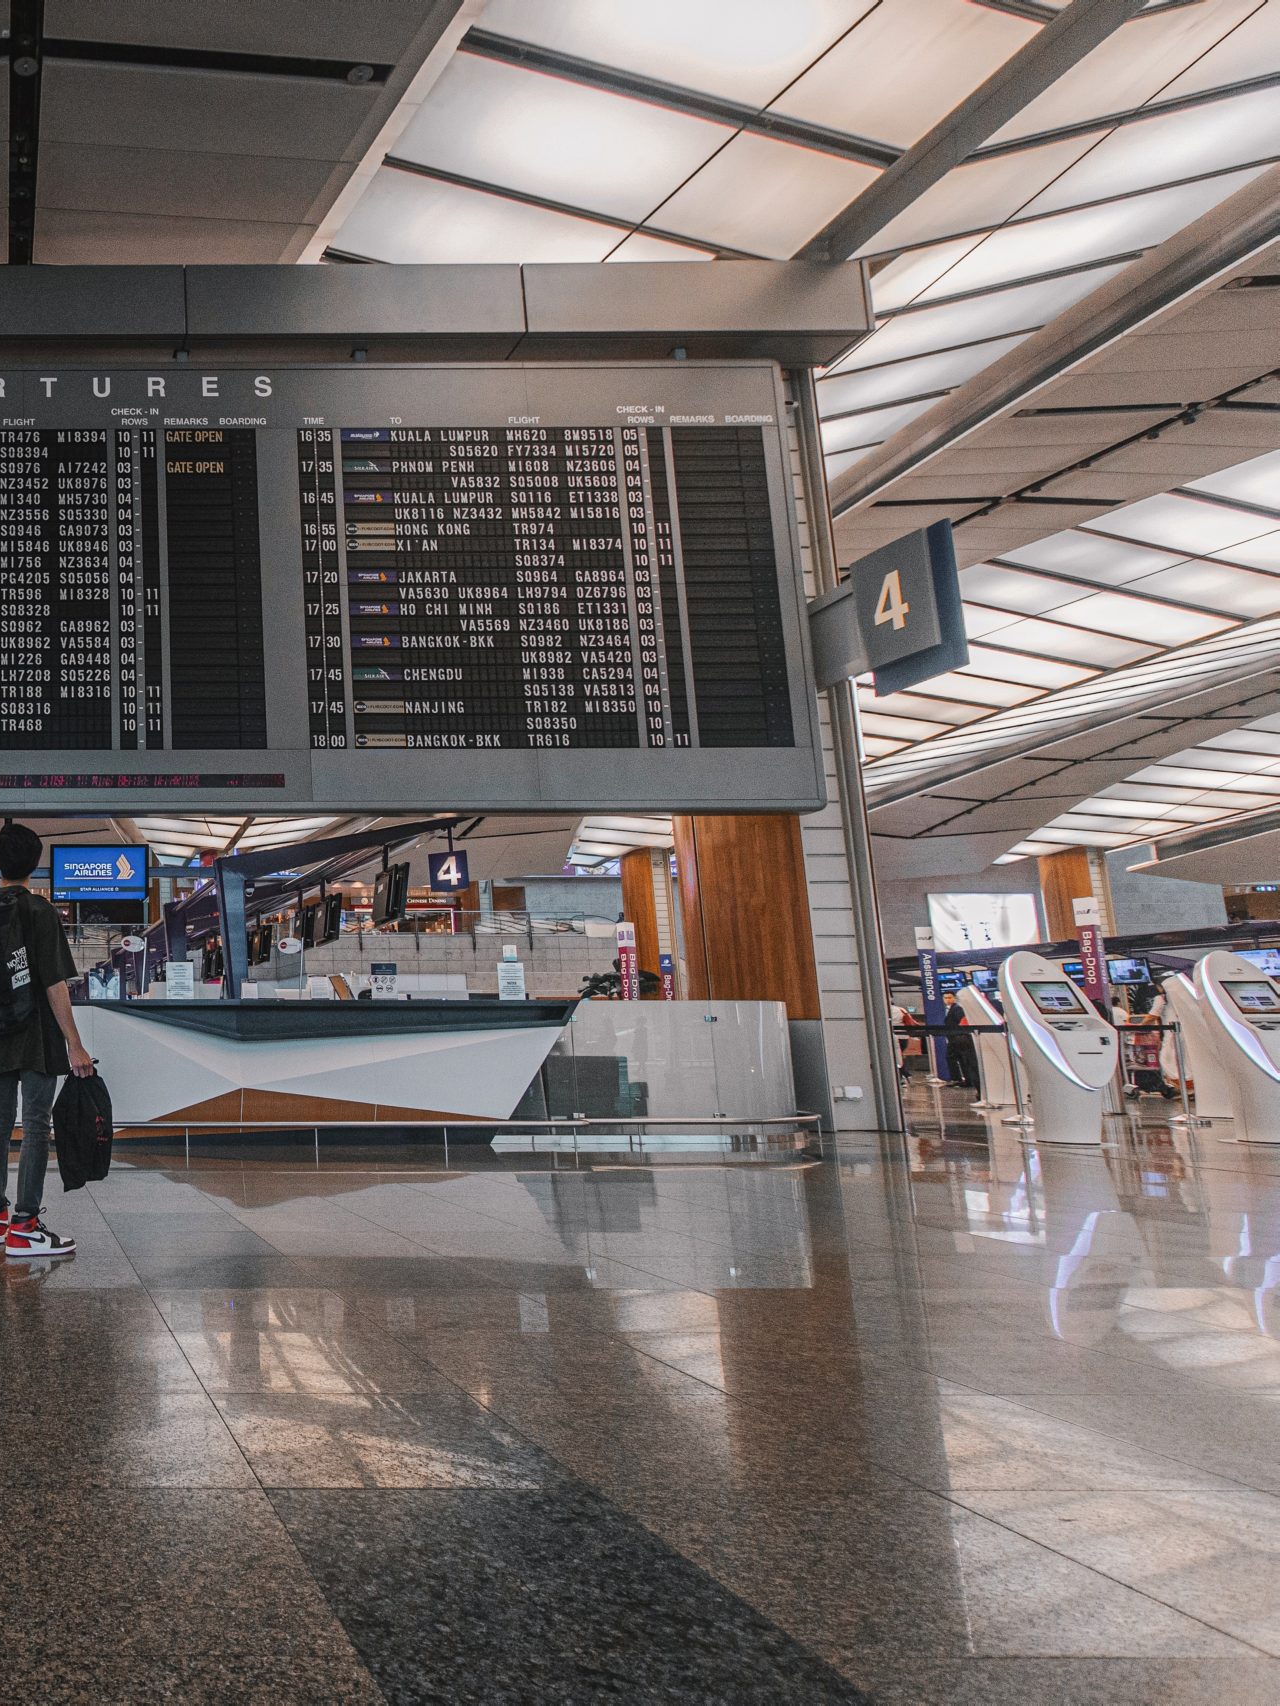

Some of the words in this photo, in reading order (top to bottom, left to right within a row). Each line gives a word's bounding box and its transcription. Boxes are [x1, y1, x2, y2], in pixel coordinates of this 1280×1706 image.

[0, 432, 39, 442] TR476
[166, 431, 192, 442] GATE
[195, 431, 222, 442] OPEN
[391, 431, 431, 441] KUALA
[441, 430, 488, 441] LUMPUR
[506, 430, 546, 440] MH620
[565, 430, 614, 440] 8M9518
[0, 447, 48, 458] SQ8394
[0, 463, 40, 473] SQ976
[167, 462, 193, 473] GATE
[196, 462, 223, 473] OPEN
[393, 461, 433, 472] PHNOM
[442, 461, 474, 472] PENH
[567, 460, 617, 471] NZ3606
[59, 478, 108, 489] UK8976
[394, 493, 435, 503] KUALA
[445, 492, 493, 503] LUMPUR
[394, 524, 428, 535] HONG
[438, 524, 470, 535] KONG
[513, 523, 553, 534] TR974
[60, 557, 110, 568] NZ3634
[399, 572, 456, 583] JAKARTA
[1, 589, 41, 600] TR596
[518, 587, 566, 598] LH9794
[874, 569, 910, 631] 4
[400, 604, 415, 615] HO
[426, 604, 447, 615] CHI
[459, 604, 492, 615] MINH
[578, 603, 626, 614] ET1331
[61, 621, 111, 632] GA8962
[521, 635, 562, 646] SQ982
[404, 669, 462, 680] CHENGDU
[404, 702, 464, 713] NANJING
[1, 719, 42, 731] TR468
[528, 734, 569, 746] TR616
[437, 856, 462, 886] 4
[1082, 931, 1097, 984] Bag-Drop
[922, 953, 936, 1001] Assistance
